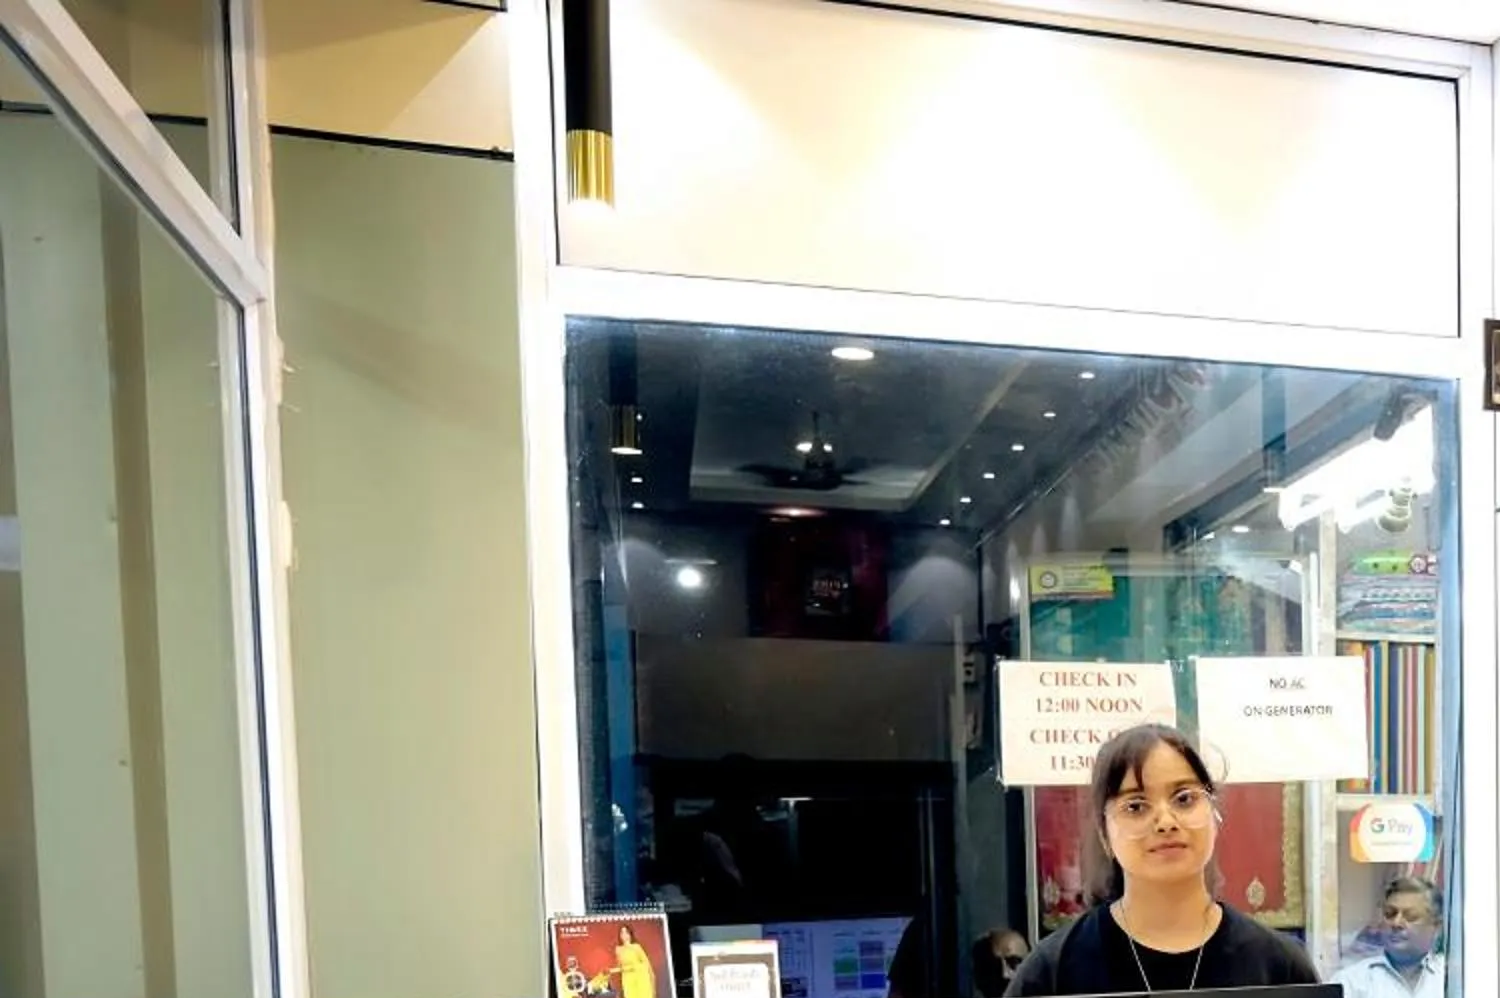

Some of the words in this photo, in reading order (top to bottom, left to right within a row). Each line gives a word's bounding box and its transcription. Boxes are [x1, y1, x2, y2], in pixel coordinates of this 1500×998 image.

[1039, 671, 1111, 687] CHECK
[1117, 671, 1138, 687] IN
[1036, 698, 1081, 713] 12:00
[1085, 697, 1144, 713] NOON
[1029, 728, 1102, 744] CHECK
[1370, 817, 1385, 834] G
